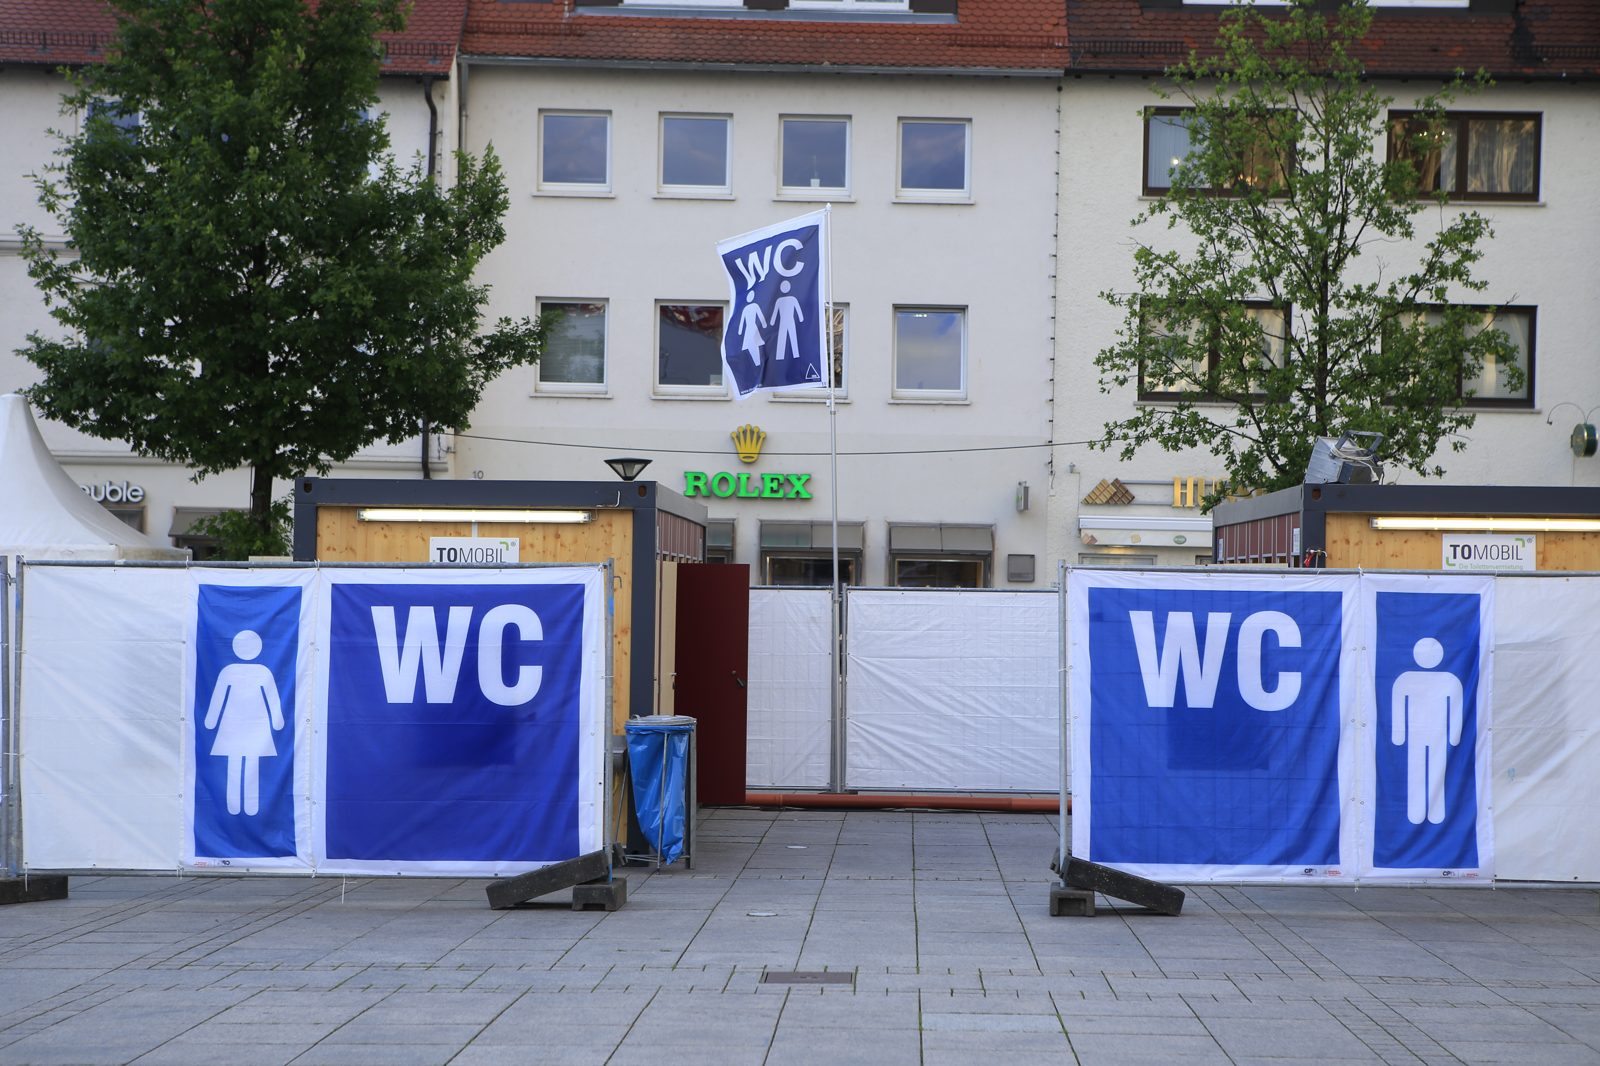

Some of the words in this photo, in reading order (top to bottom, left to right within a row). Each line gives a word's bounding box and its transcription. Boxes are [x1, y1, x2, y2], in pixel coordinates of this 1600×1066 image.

[735, 238, 805, 290] WC
[472, 470, 484, 479] 10
[683, 471, 813, 500] ROLEX
[436, 547, 506, 563] TOMOBIL
[1449, 544, 1523, 561] TOMOBIL
[371, 603, 543, 706] WC
[1128, 610, 1301, 711] WC
